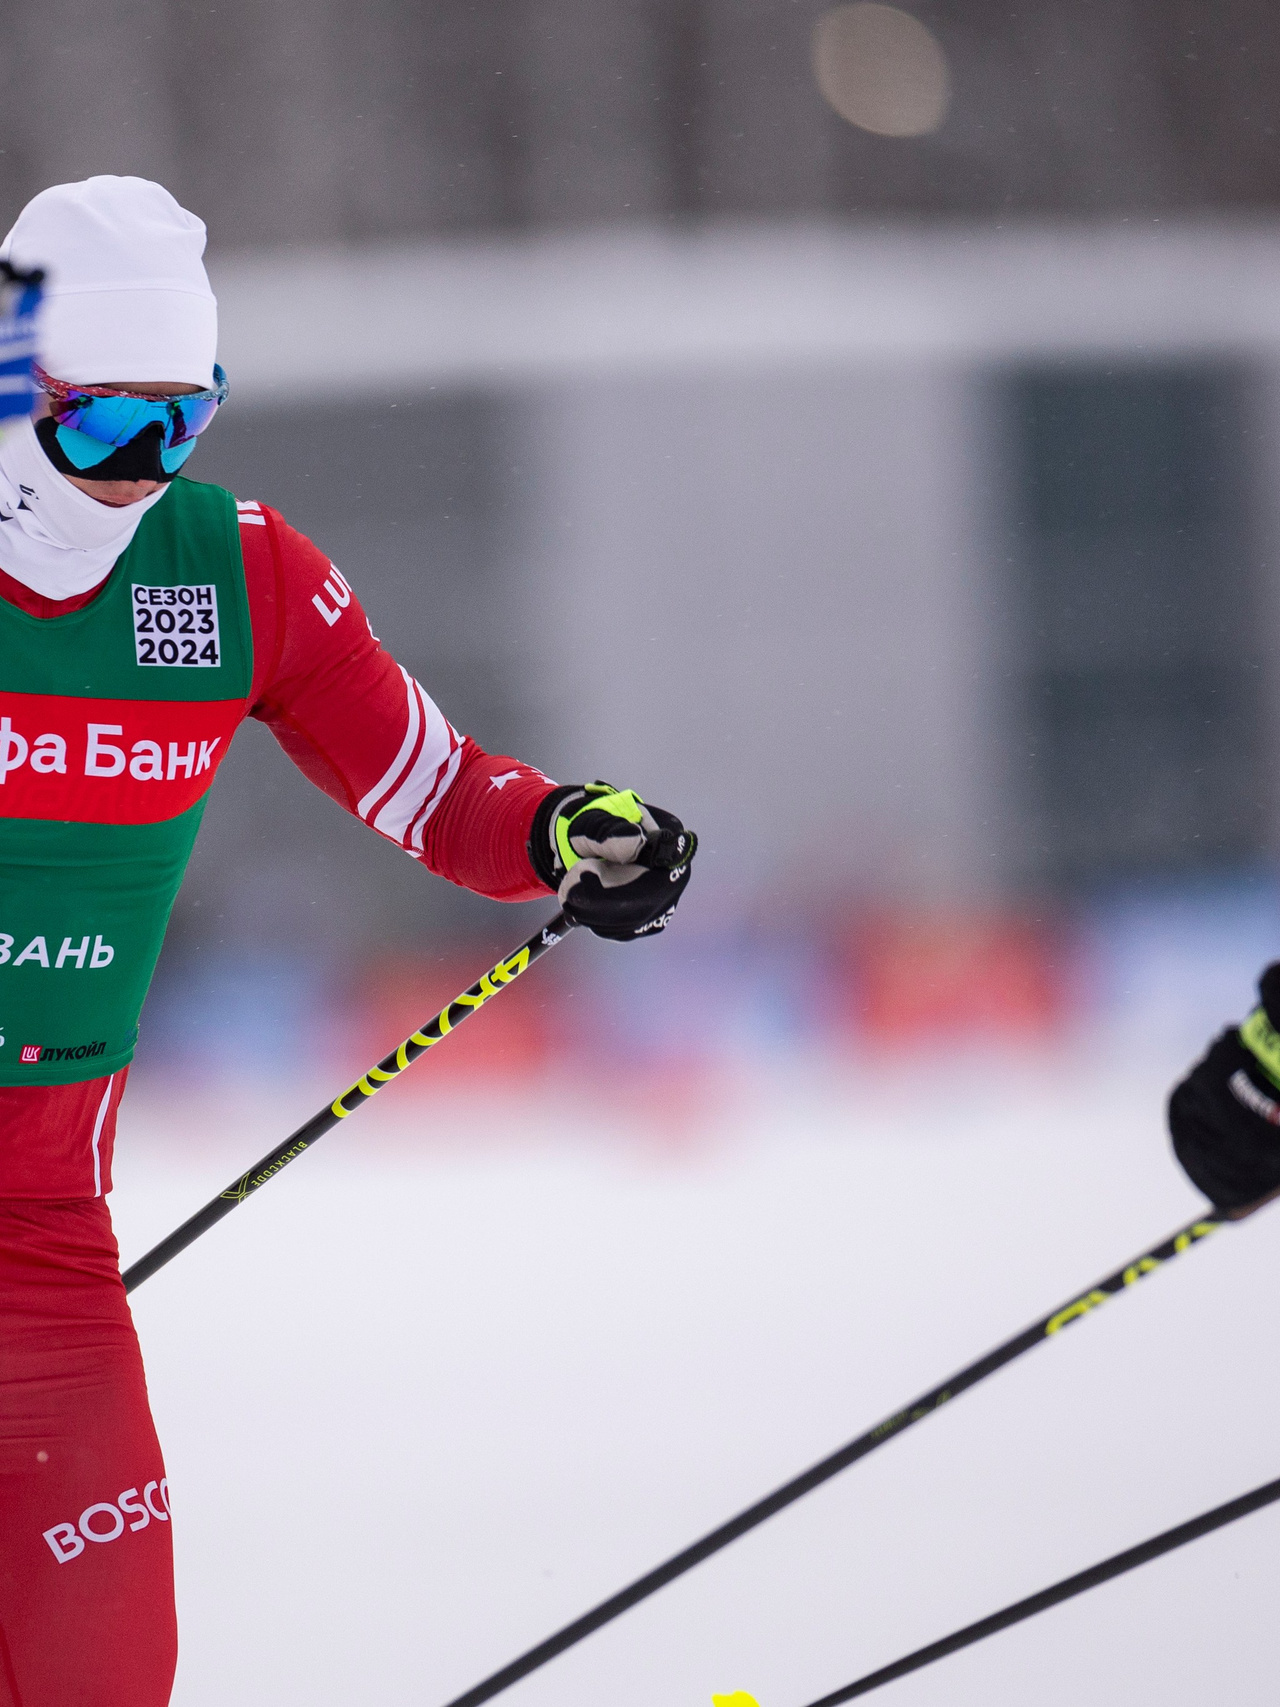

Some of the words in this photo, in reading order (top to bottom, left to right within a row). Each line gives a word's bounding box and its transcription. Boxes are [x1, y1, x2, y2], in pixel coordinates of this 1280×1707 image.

[133, 586, 213, 607] СЕЗОН
[136, 607, 215, 635] 2023
[137, 637, 220, 666] 2024
[83, 722, 222, 781] Банк
[40, 1041, 107, 1062] ЛУКОЙЛ
[251, 1141, 308, 1187] BLACKCODE
